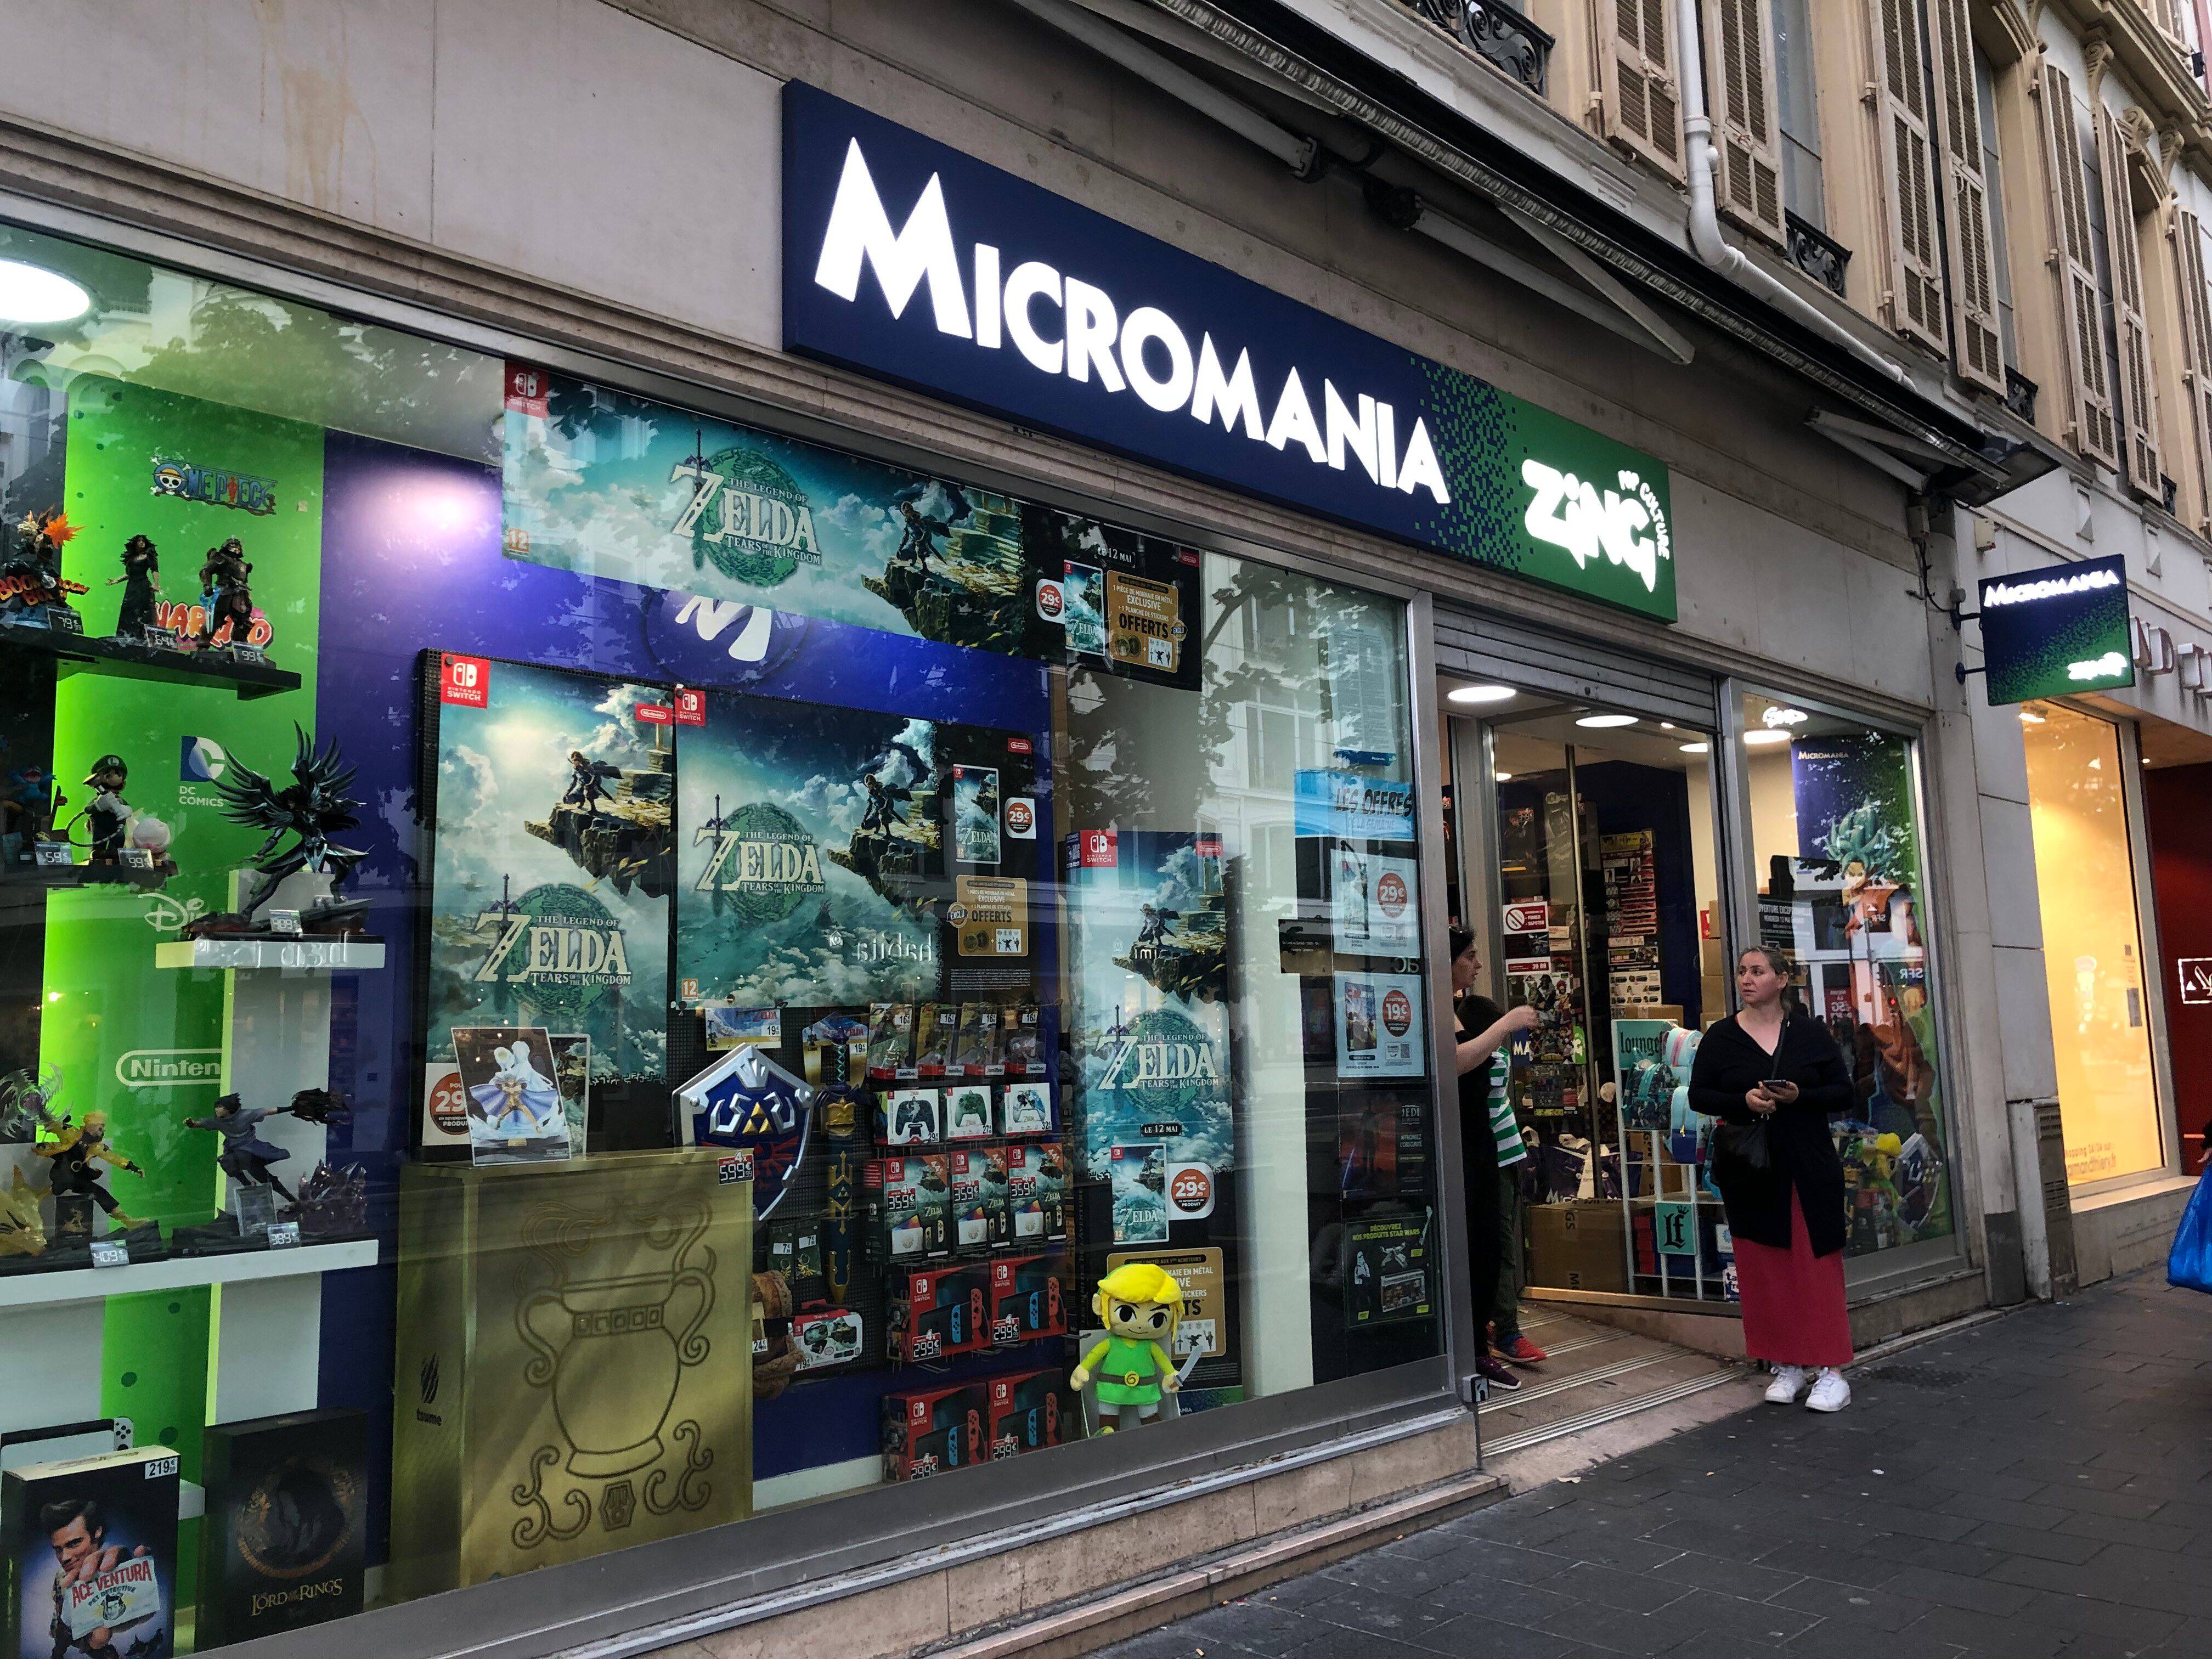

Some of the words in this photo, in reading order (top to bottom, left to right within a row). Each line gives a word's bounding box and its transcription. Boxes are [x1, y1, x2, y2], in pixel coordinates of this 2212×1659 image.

[814, 136, 1451, 504] MICROMANIA
[730, 477, 749, 489] THE
[753, 484, 793, 500] LEGEND
[795, 494, 808, 503] OF
[670, 464, 821, 555] ZELDA
[1640, 483, 1670, 560] CULTURE
[510, 530, 528, 549] 12
[725, 535, 762, 551] TEARS
[774, 545, 821, 565] KINGDOM
[1109, 548, 1118, 560] 12
[1120, 552, 1132, 563] MAI
[1984, 569, 2120, 607] MICROMANIA
[1127, 594, 1161, 611] EXCLUSIVE
[1125, 606, 1144, 616] PLANCHE
[1151, 612, 1169, 622] STICKERS
[1119, 613, 1169, 639] OFFERTS
[447, 691, 482, 701] SWITCH
[643, 709, 664, 718] Nintendo
[1797, 751, 1849, 760] MICROMANIA
[179, 786, 196, 795] DC
[179, 797, 223, 808] COMICS
[1335, 787, 1358, 814] LES
[1362, 788, 1413, 817] OFFRES
[744, 831, 764, 839] THE
[766, 832, 800, 842] LEGEND
[801, 833, 812, 842] OF
[961, 827, 992, 845] ZELDA
[695, 827, 825, 891] ZELDA
[742, 881, 774, 893] TEARS
[783, 882, 824, 894] KINGDOM
[537, 915, 559, 924] THE
[563, 916, 603, 927] LEGEND
[606, 918, 619, 927] OF
[950, 911, 965, 920] EXCLU
[972, 910, 1012, 923] OFFERTS
[474, 911, 631, 983] ZELDA
[531, 972, 568, 984] TEARS
[581, 974, 631, 986] KINGDOM
[682, 980, 697, 996] 12
[1162, 1034, 1194, 1042] LEGEND
[1096, 1034, 1219, 1090] ZELDA
[1140, 1079, 1170, 1090] TEARS
[1180, 1078, 1219, 1090] KINGDOM
[1402, 1107, 1420, 1116] JEDI
[1154, 1124, 1164, 1133] 12
[988, 1198, 1005, 1209] ZELDA
[1043, 1192, 1061, 1202] ZELDA
[924, 1206, 944, 1217] ZELDA
[1119, 1207, 1159, 1227] ZELDA
[1115, 1229, 1123, 1238] 12
[1363, 1231, 1389, 1239] PRODUITS
[1193, 1266, 1214, 1275] MÉTAL
[1181, 1289, 1207, 1298] TICKERS
[71, 1583, 94, 1609] ACE
[97, 1560, 153, 1592] VENTURA
[300, 1578, 343, 1601] RINGS
[88, 1595, 100, 1606] PET
[100, 1585, 137, 1597] DETECTIVE
[251, 1592, 288, 1616] LORD
